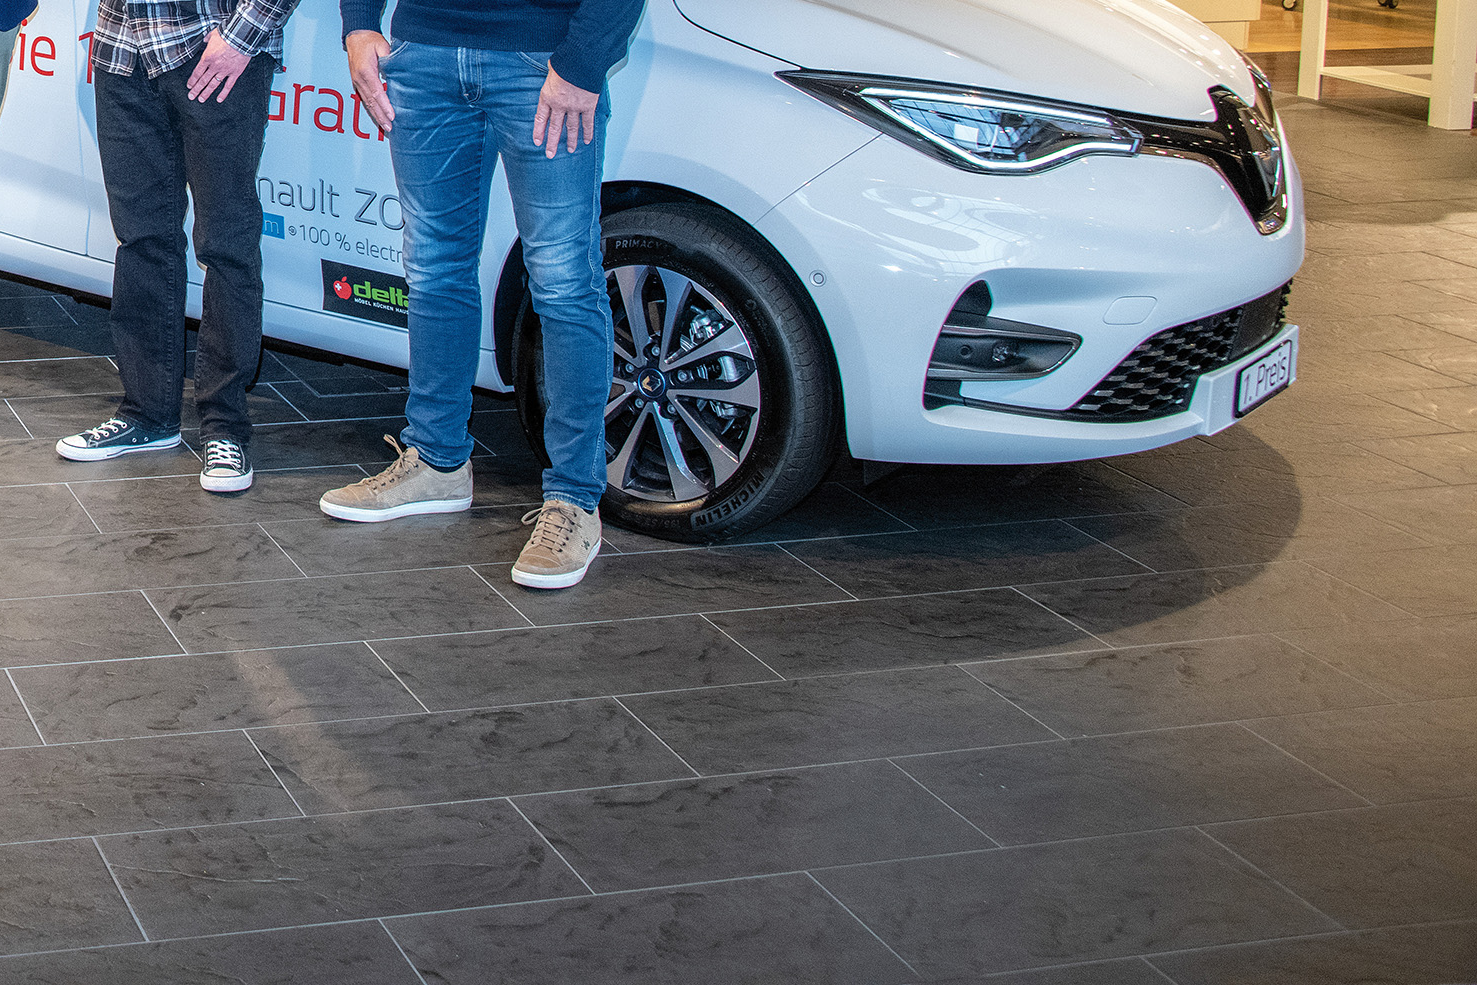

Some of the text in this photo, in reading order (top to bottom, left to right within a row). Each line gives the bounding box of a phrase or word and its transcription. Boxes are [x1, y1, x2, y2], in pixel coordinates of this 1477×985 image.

[10, 18, 56, 76] ie
[257, 176, 406, 231] nault ZO
[299, 224, 331, 247] 100
[334, 231, 351, 252] %
[355, 238, 403, 263] electr
[1256, 351, 1287, 397] Preis
[693, 471, 765, 528] MICHELIN
